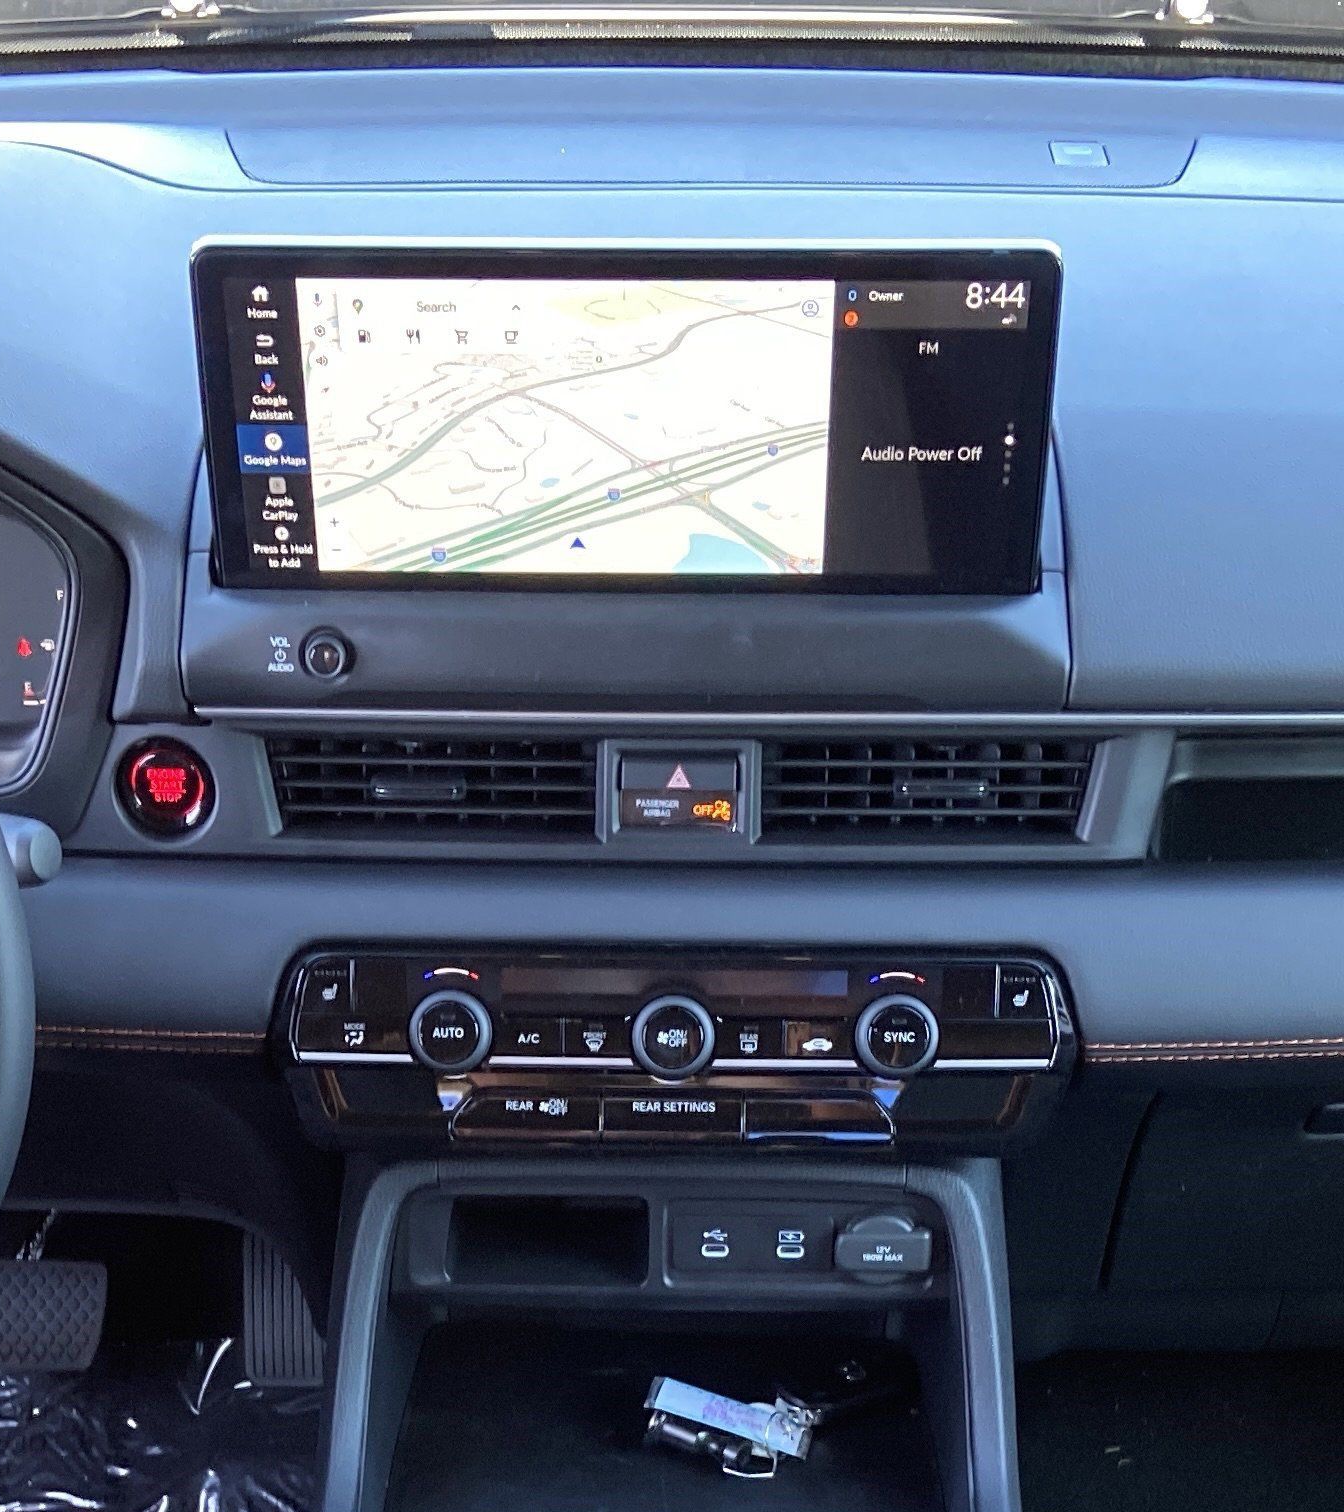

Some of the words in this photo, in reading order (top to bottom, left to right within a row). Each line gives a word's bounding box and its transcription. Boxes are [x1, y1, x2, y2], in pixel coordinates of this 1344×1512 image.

[868, 291, 904, 302] Owner
[965, 282, 1026, 309] 8:44
[416, 300, 457, 314] Search
[246, 307, 278, 320] Home
[918, 341, 940, 355] FM
[254, 354, 279, 366] Back
[252, 395, 288, 408] Google
[249, 408, 294, 421] Assistant
[861, 446, 905, 462] Audio
[908, 446, 955, 462] Power
[957, 446, 984, 462] Off
[244, 455, 278, 467] Google
[281, 455, 307, 467] Maps
[265, 497, 294, 509] Apple
[262, 511, 299, 523] CarPlay
[253, 543, 278, 556] Press
[290, 543, 314, 556] Hold
[268, 558, 279, 568] to
[280, 557, 301, 568] Add
[56, 589, 64, 601] F
[269, 636, 291, 648] VOL
[268, 663, 294, 673] AUDIO
[146, 768, 186, 780] ENGINE
[150, 780, 183, 790] START
[154, 792, 182, 803] STOP
[636, 799, 680, 809] PASSENGER
[692, 804, 714, 816] OFF
[432, 1026, 465, 1039] AUTO
[517, 1032, 540, 1044] A/C
[583, 1031, 607, 1039] FRONT
[883, 1031, 916, 1043] SYNC
[668, 1038, 688, 1048] OFF
[506, 1100, 534, 1111] REAR
[549, 1107, 568, 1116] OFF
[632, 1101, 661, 1112] REAR
[663, 1101, 716, 1113] SETTINGS
[884, 1253, 904, 1262] MAX
